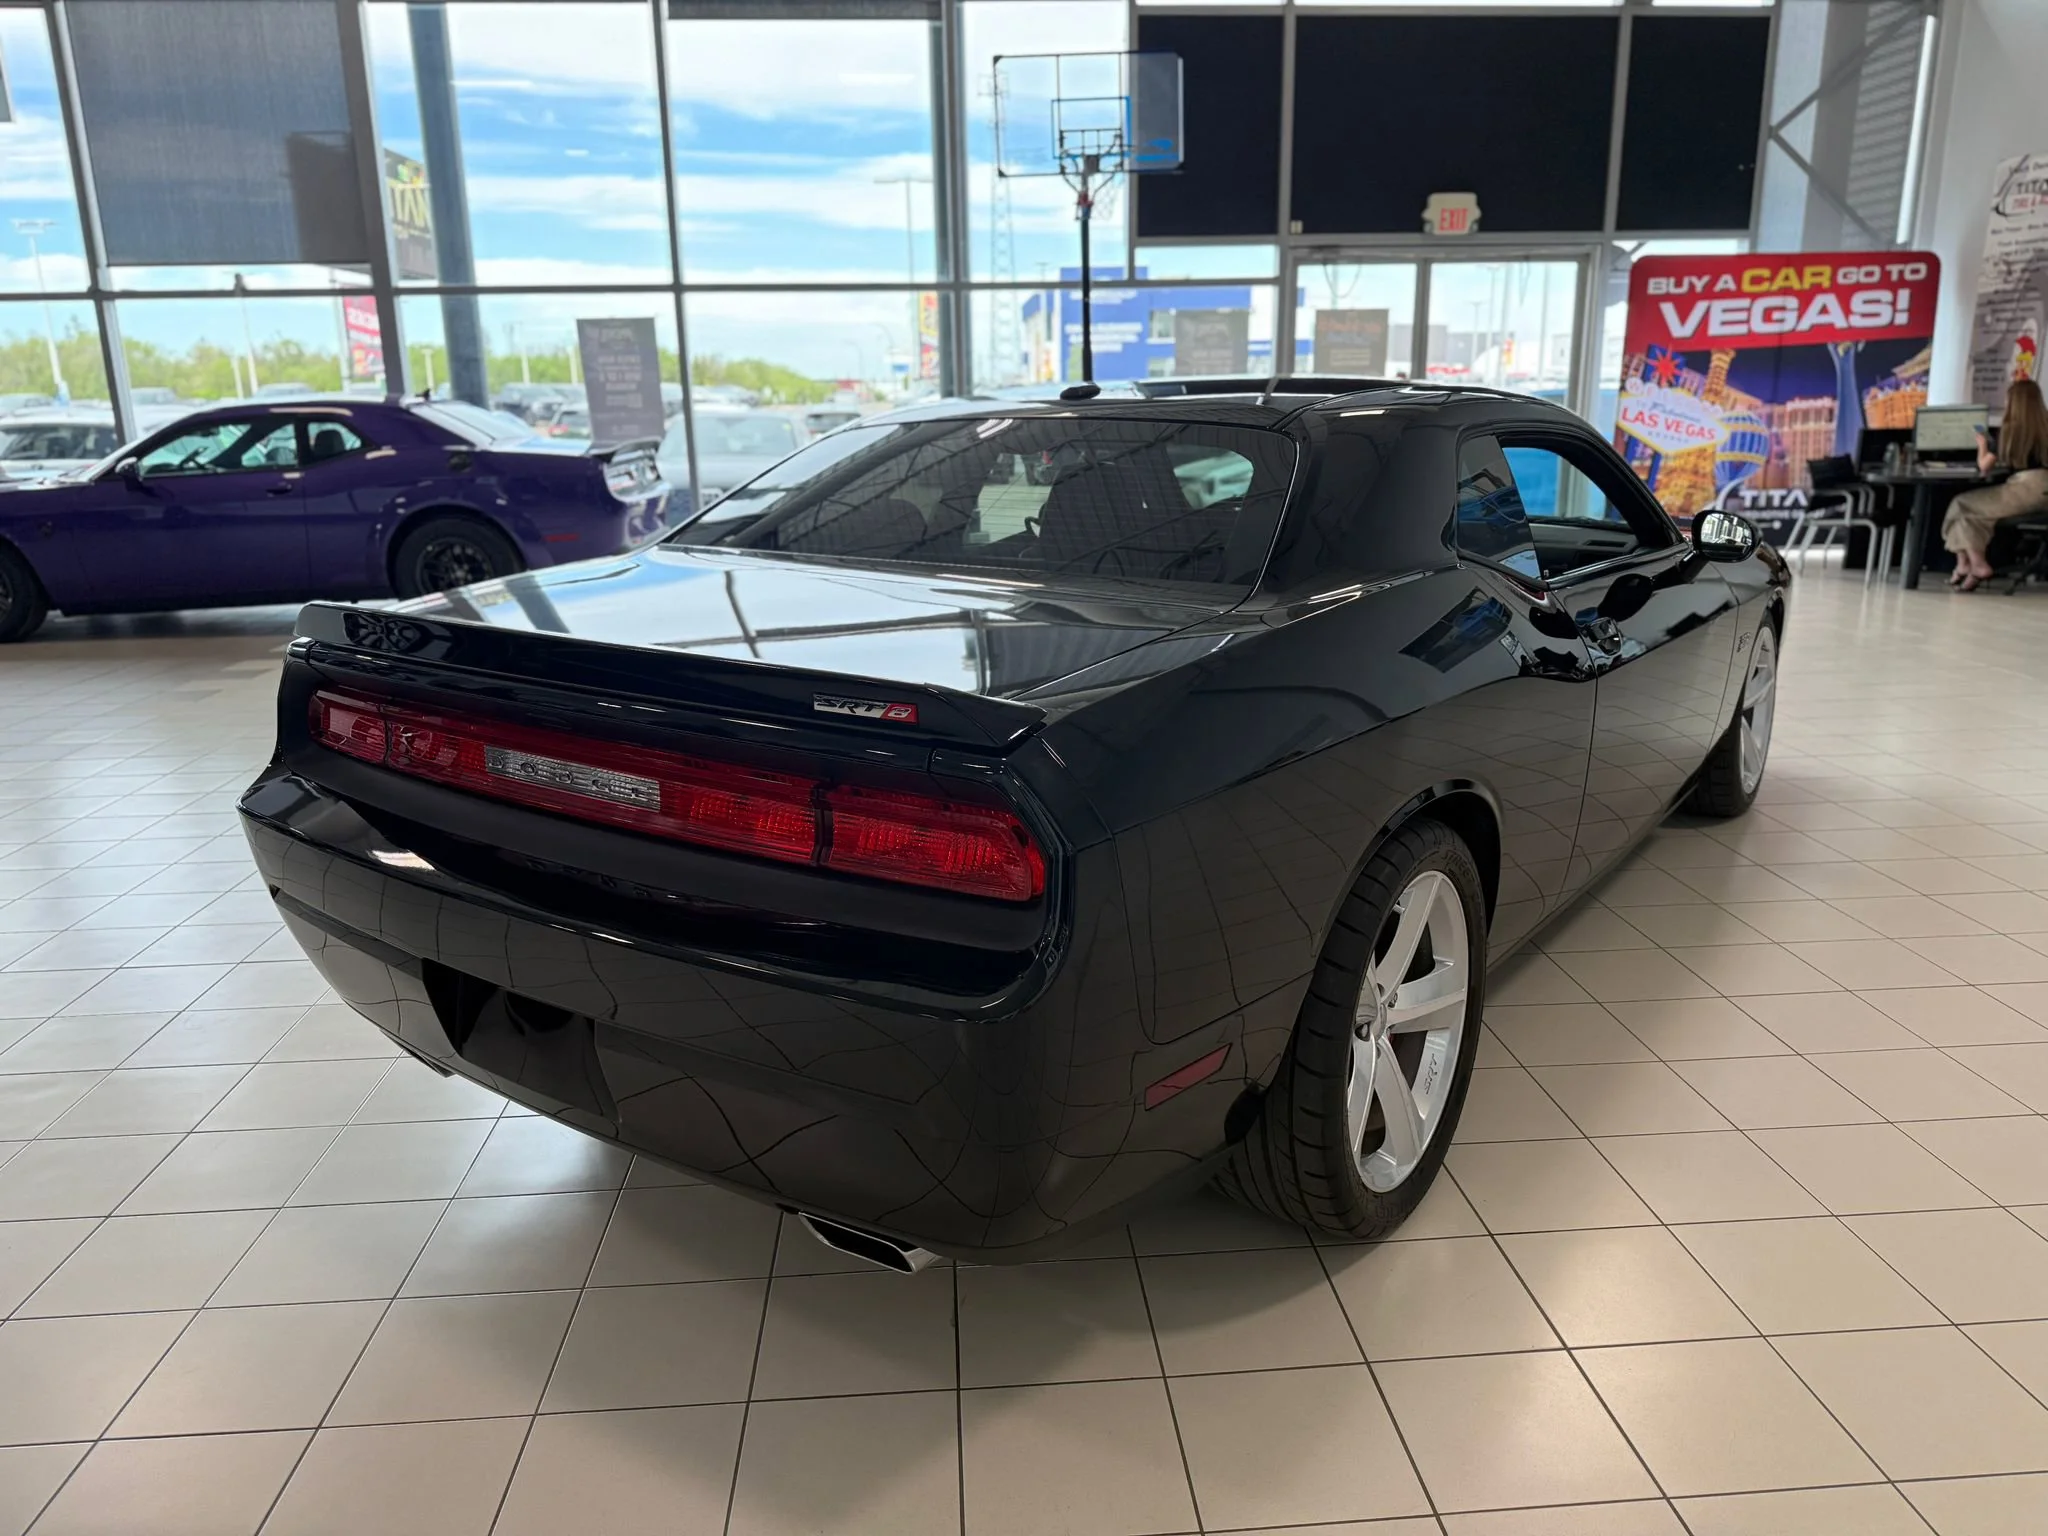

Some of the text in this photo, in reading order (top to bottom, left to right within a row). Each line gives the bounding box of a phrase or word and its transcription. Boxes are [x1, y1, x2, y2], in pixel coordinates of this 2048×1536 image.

[1439, 207, 1468, 231] EXIT
[1647, 262, 1927, 295] BUY A CAR GO TO
[1659, 288, 1911, 339] VEGAS!
[1621, 407, 1659, 428] LAS
[1664, 417, 1716, 442] VEGAS
[1738, 489, 1808, 508] TITA
